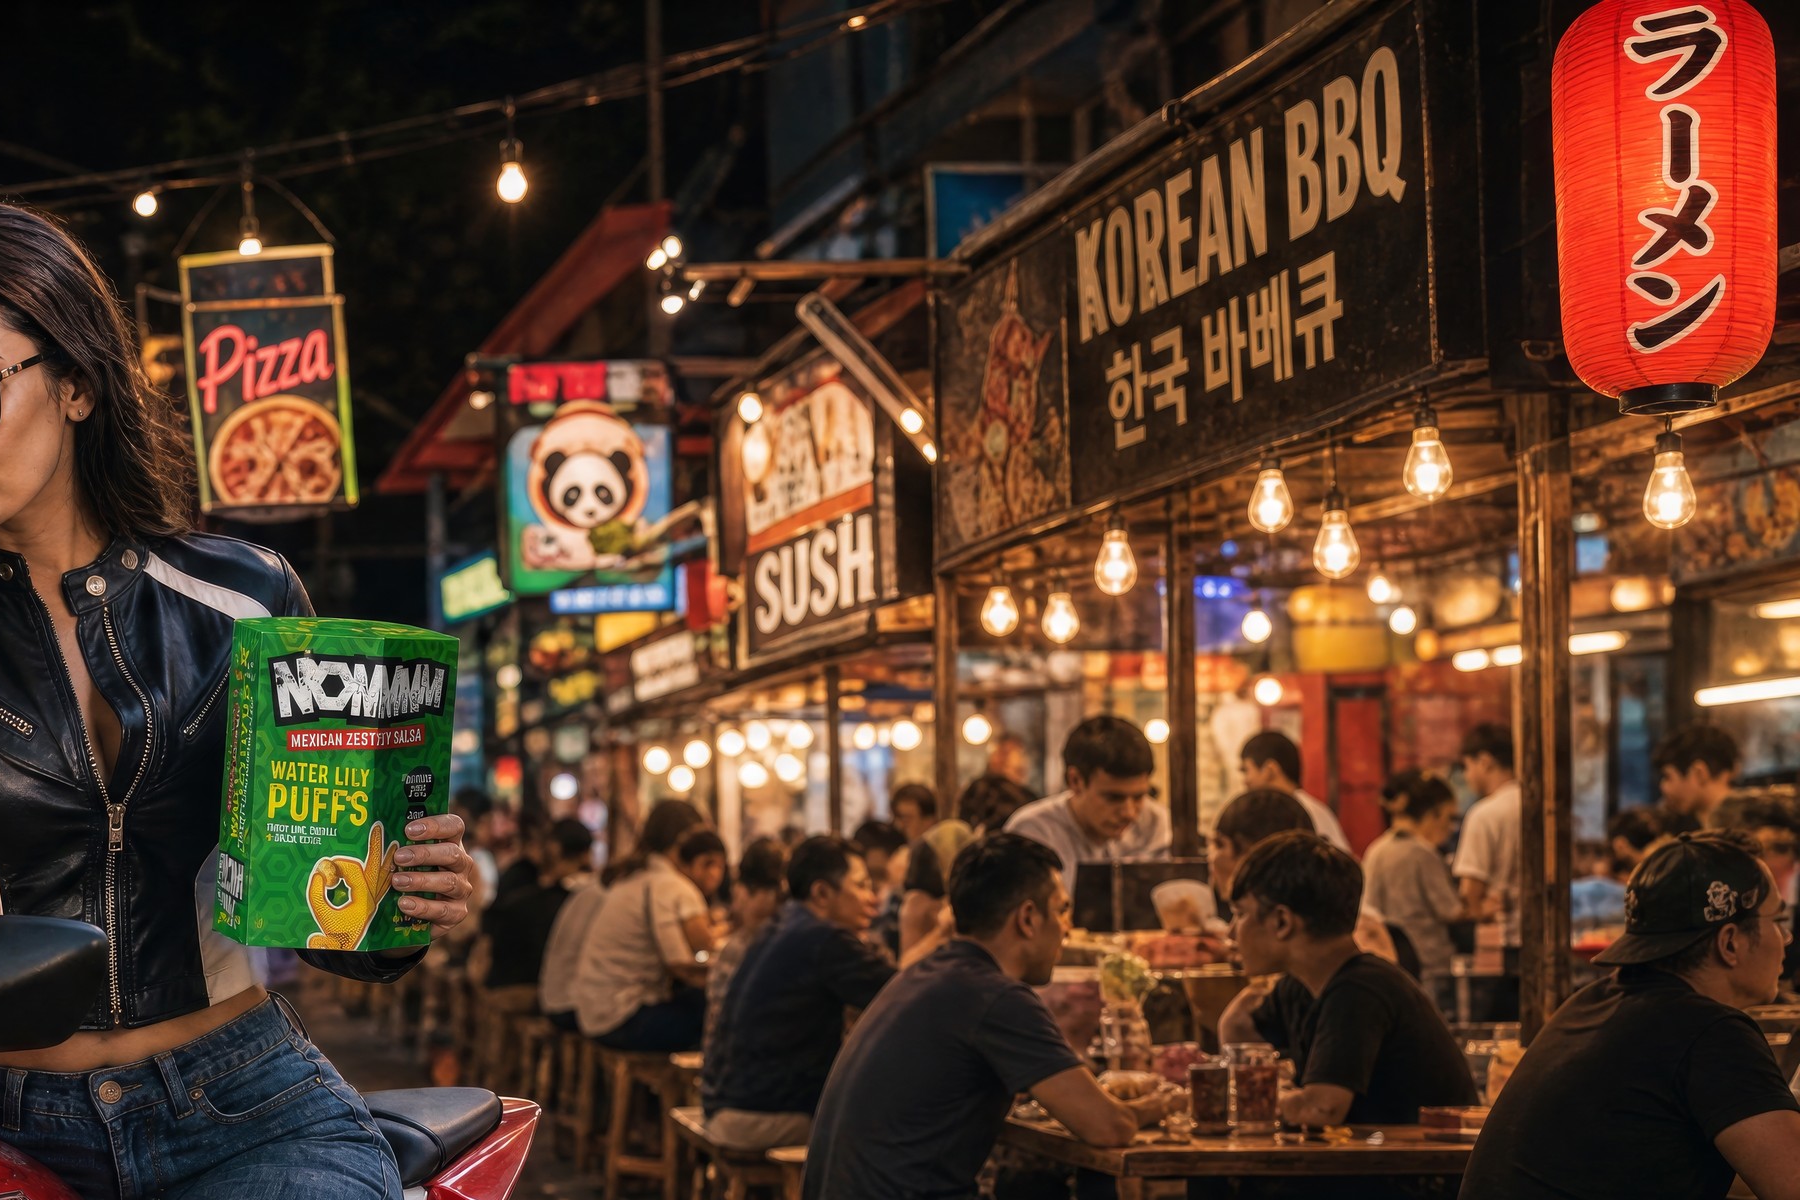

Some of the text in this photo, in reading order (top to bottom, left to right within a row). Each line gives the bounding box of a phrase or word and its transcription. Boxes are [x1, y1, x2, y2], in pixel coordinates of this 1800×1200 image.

[1075, 47, 1406, 344] KOREAN BBQ
[1624, 5, 1728, 354] ラーメン
[197, 325, 335, 414] Pizza
[1105, 251, 1344, 450] 한국 바베큐
[271, 760, 370, 788] WATER LILY
[291, 733, 342, 748] MEXICAN
[394, 728, 422, 745] SALSA
[268, 783, 368, 827] PUFFS
